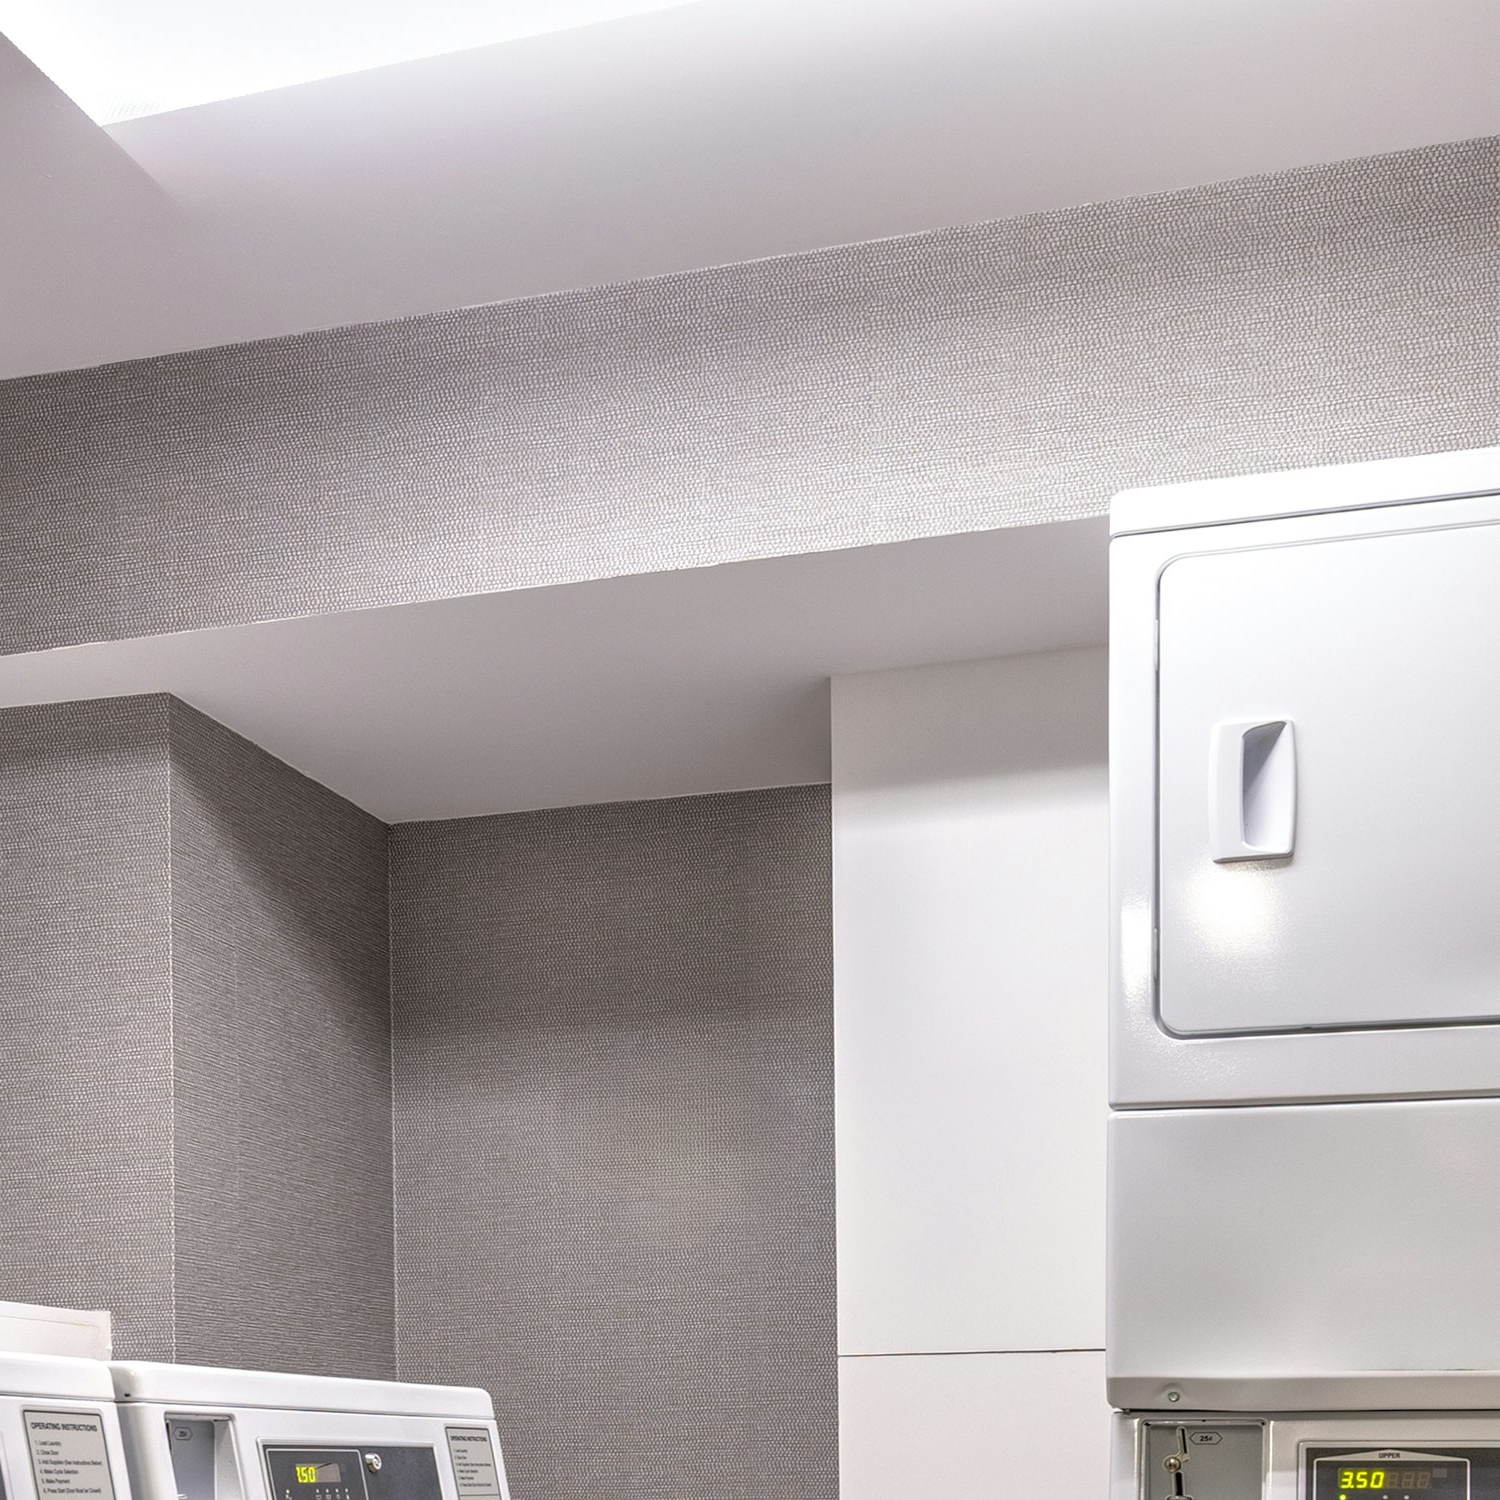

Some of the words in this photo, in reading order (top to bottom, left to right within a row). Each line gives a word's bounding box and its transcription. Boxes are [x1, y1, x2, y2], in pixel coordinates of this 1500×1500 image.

[31, 1422, 60, 1430] OPERATING
[62, 1423, 97, 1432] INSTRUCTIONS
[1341, 1471, 1385, 1489] 3.50
